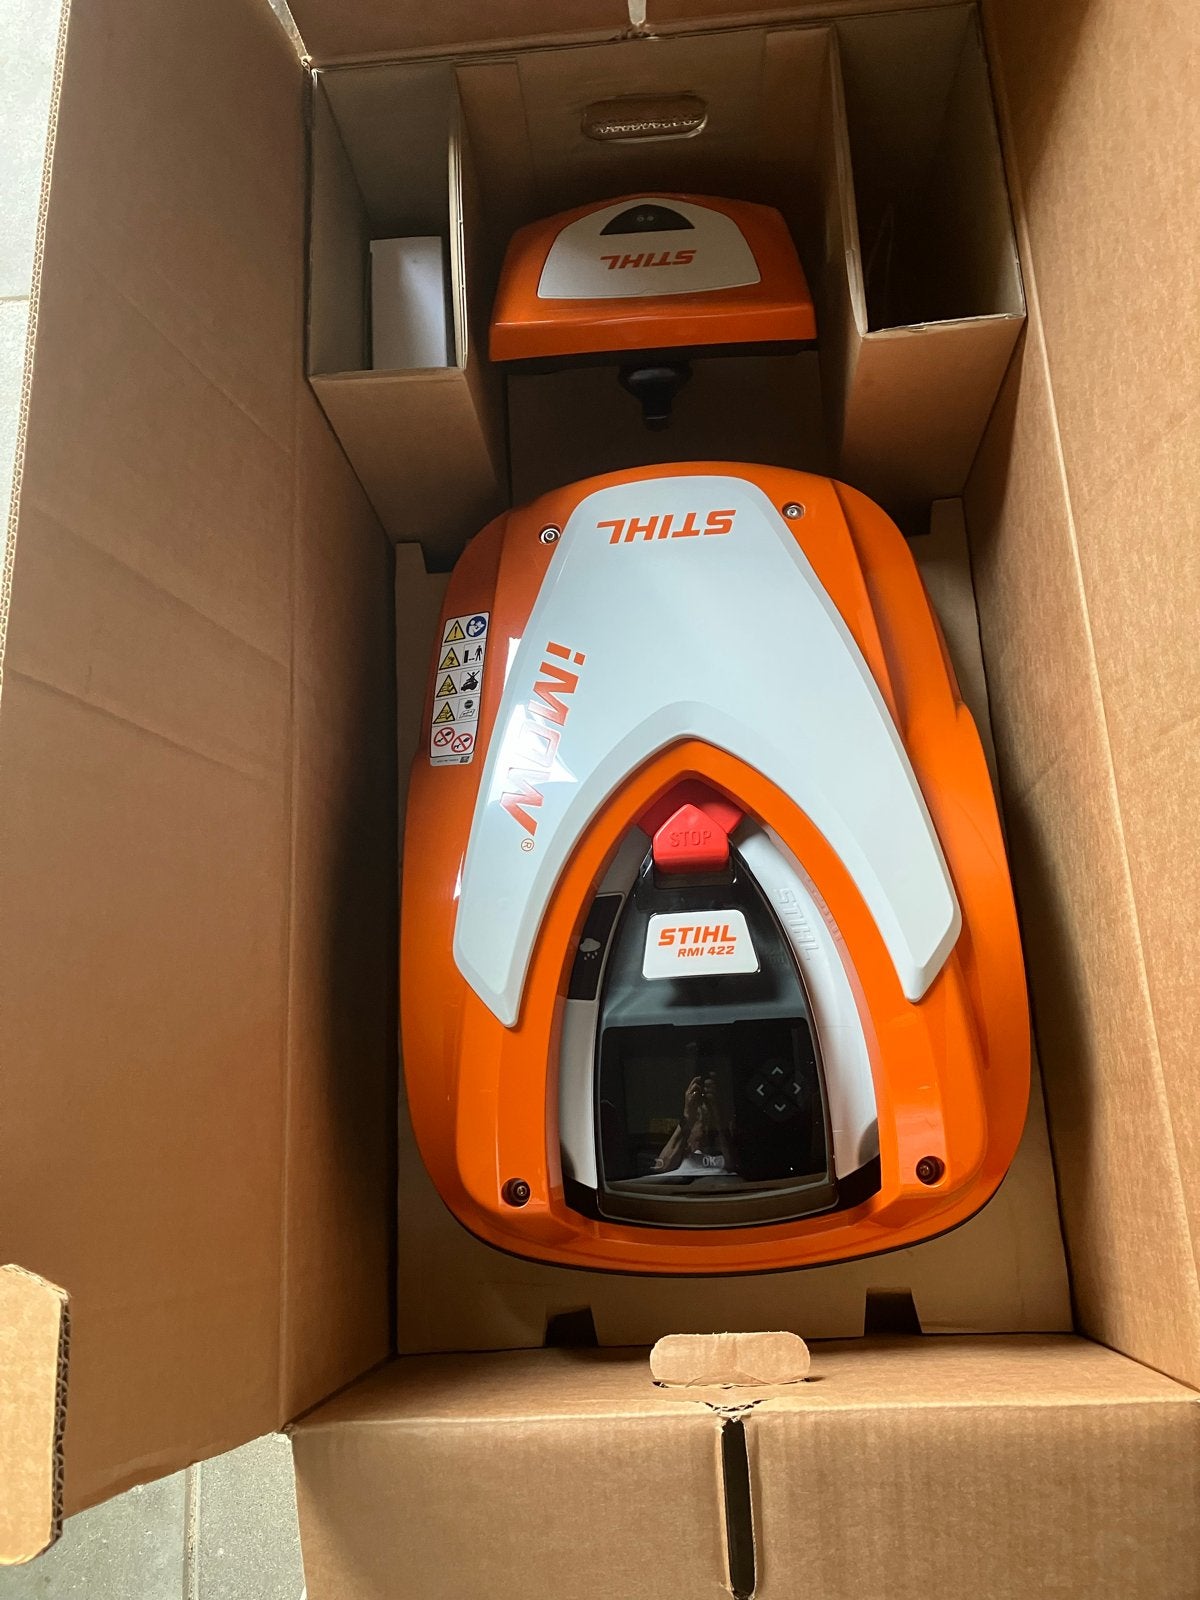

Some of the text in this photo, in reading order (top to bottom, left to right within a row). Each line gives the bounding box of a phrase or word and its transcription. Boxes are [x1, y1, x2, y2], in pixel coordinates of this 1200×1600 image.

[600, 249, 697, 270] STIHL
[596, 509, 737, 545] STIHL
[669, 829, 712, 848] STOP
[774, 887, 819, 961] STIHL
[658, 924, 737, 947] STIHL
[677, 945, 735, 958] RMI 422
